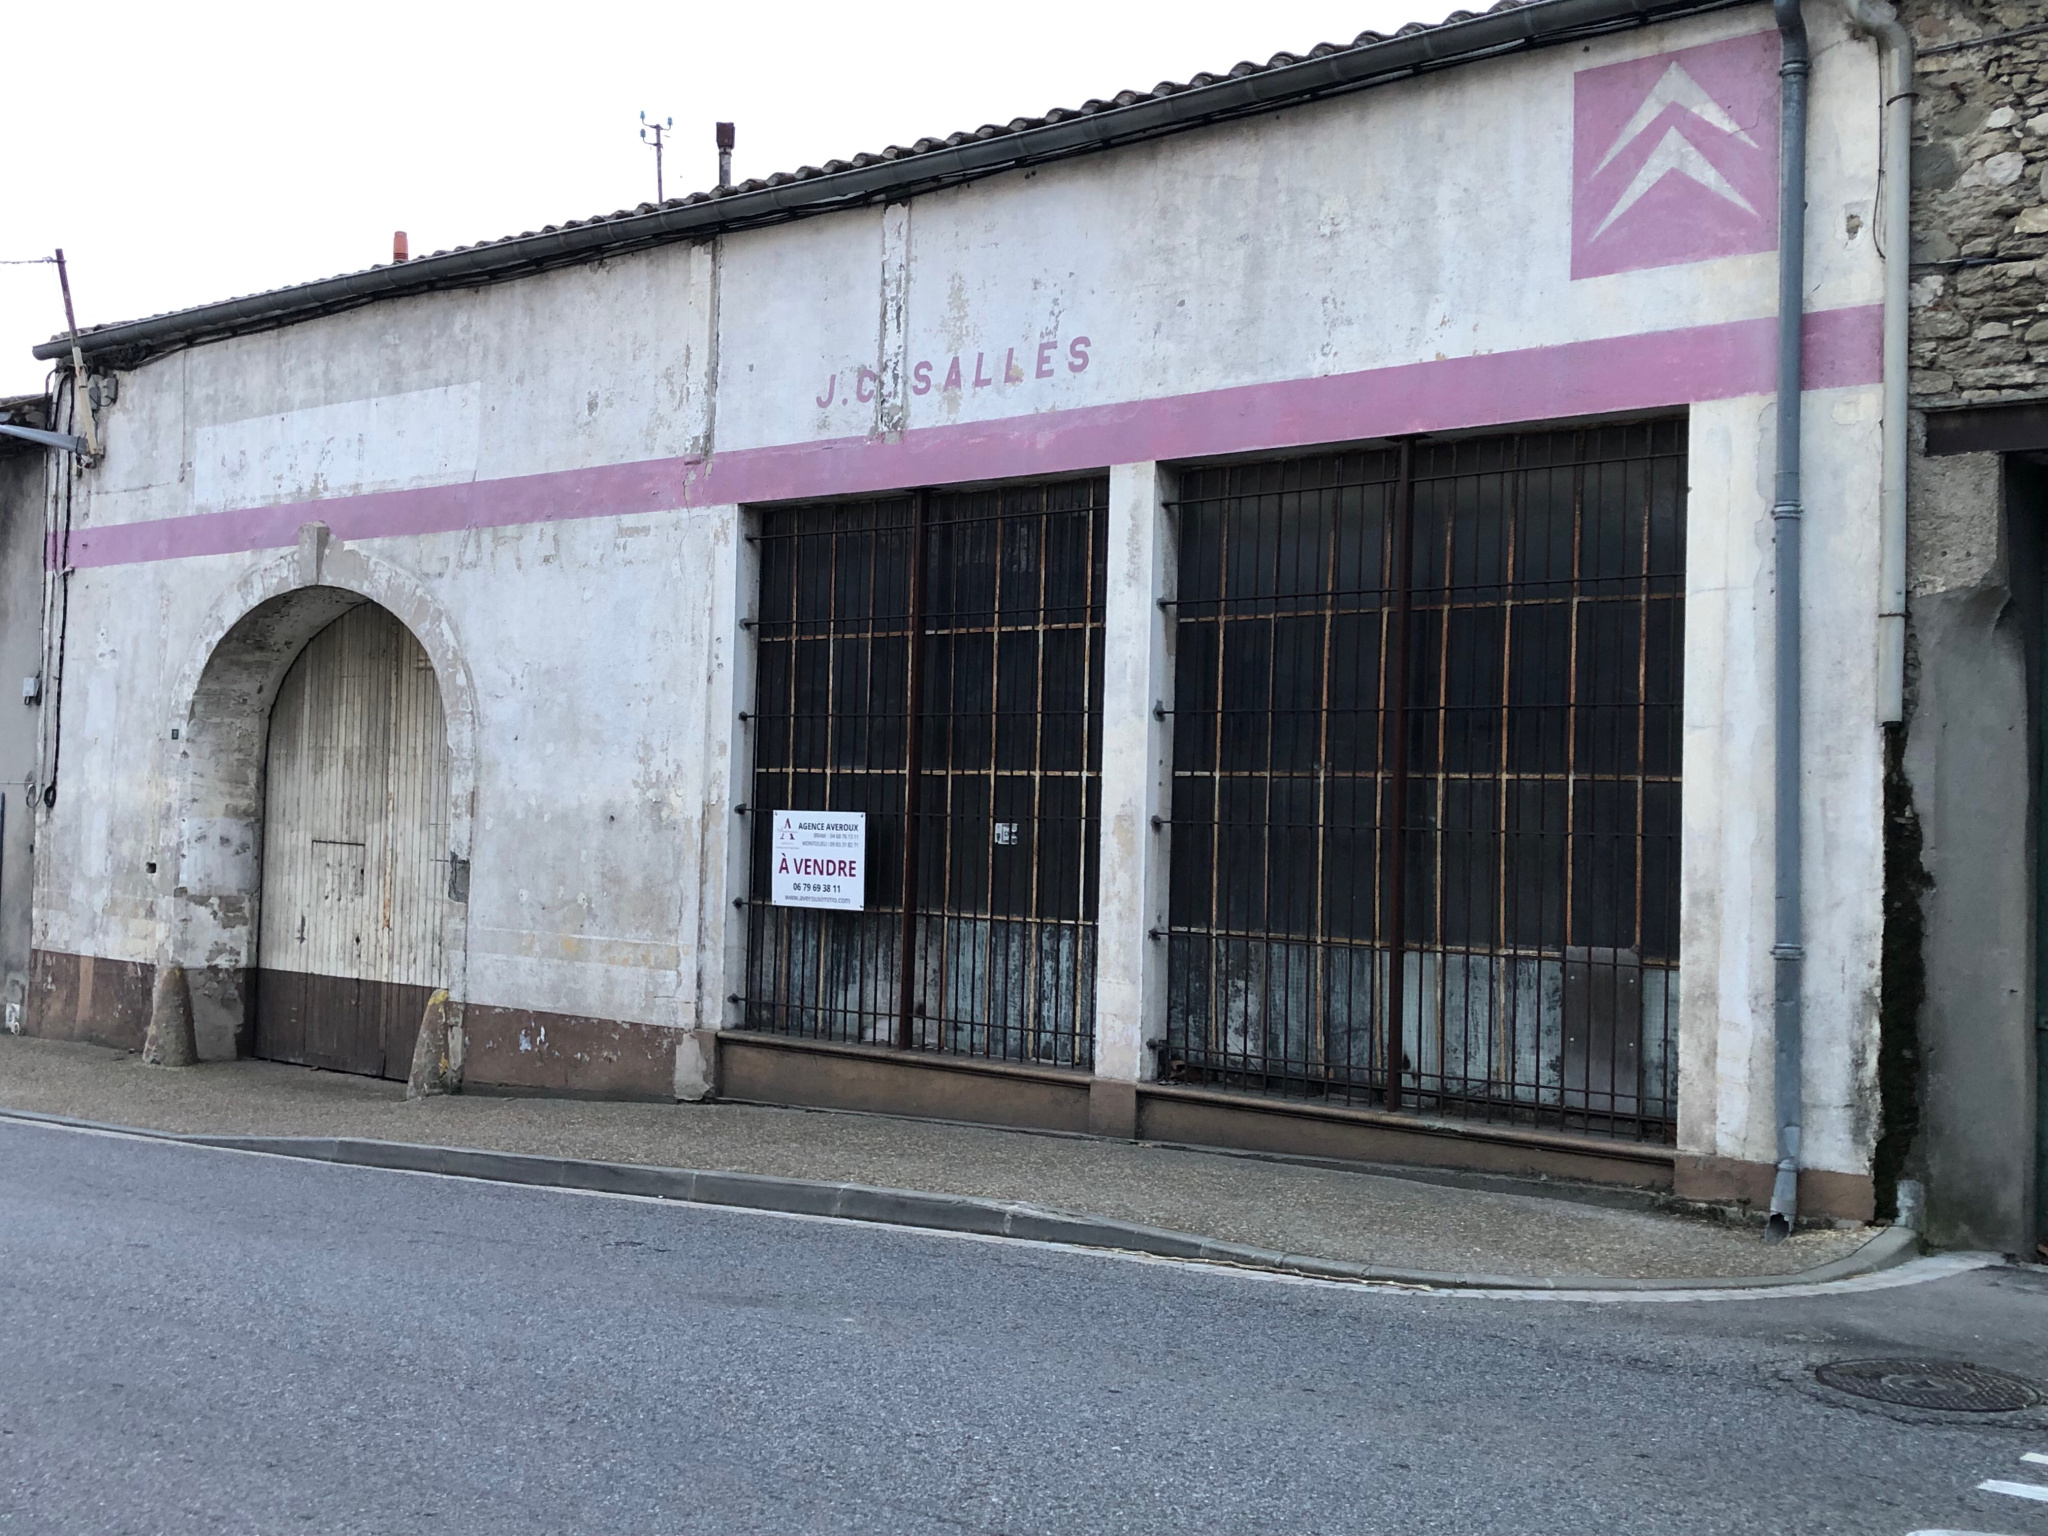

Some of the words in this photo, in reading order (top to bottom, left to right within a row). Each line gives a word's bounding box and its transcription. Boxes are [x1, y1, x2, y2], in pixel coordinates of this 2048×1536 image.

[912, 336, 1092, 396] SALLES
[798, 823, 825, 831] AGENCE
[826, 823, 859, 832] AVEROUX
[779, 853, 789, 874] À
[793, 858, 857, 877] VENDRE
[793, 883, 801, 891] 06
[803, 883, 811, 891] 79
[812, 884, 821, 892] 69
[823, 884, 831, 892] 38
[833, 885, 841, 893] 11
